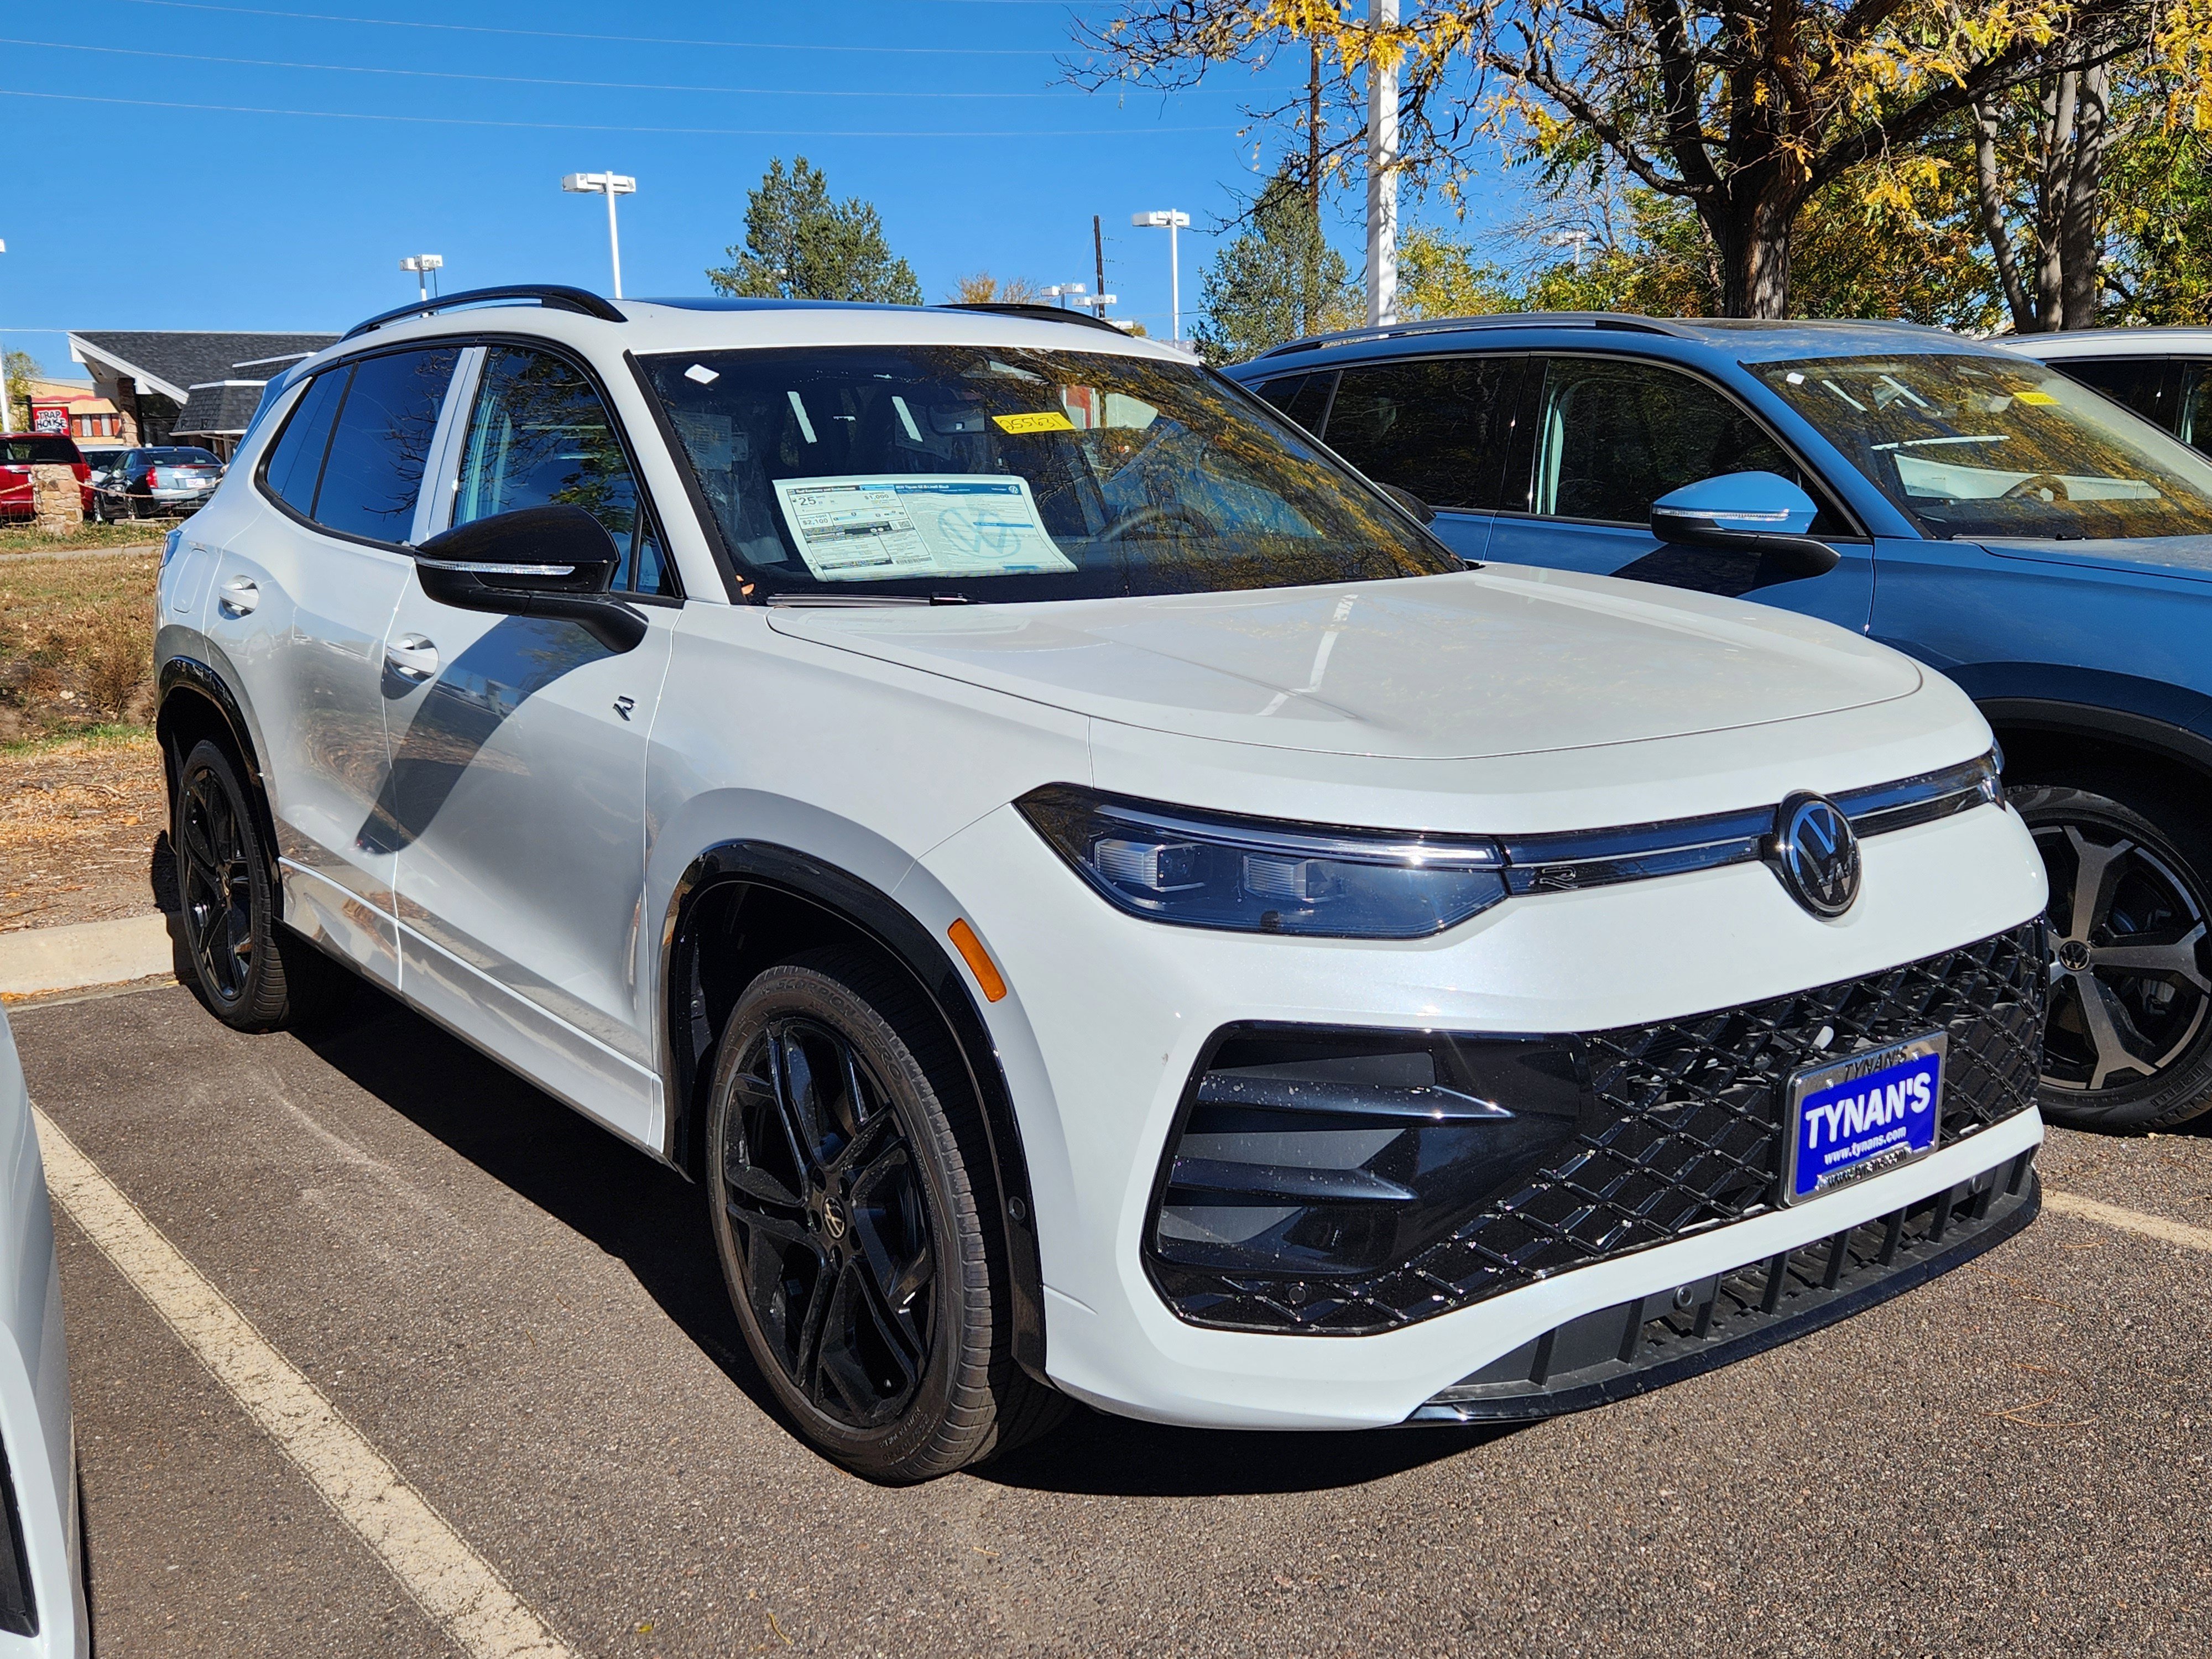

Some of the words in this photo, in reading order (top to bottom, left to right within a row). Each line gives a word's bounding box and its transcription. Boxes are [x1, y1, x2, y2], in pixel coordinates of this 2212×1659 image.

[38, 411, 61, 419] TRAP
[36, 419, 66, 429] HOUSE
[798, 497, 817, 506] 25
[1805, 1072, 1932, 1150] TYNAN'S
[1824, 1126, 1907, 1166] www.tynans.com
